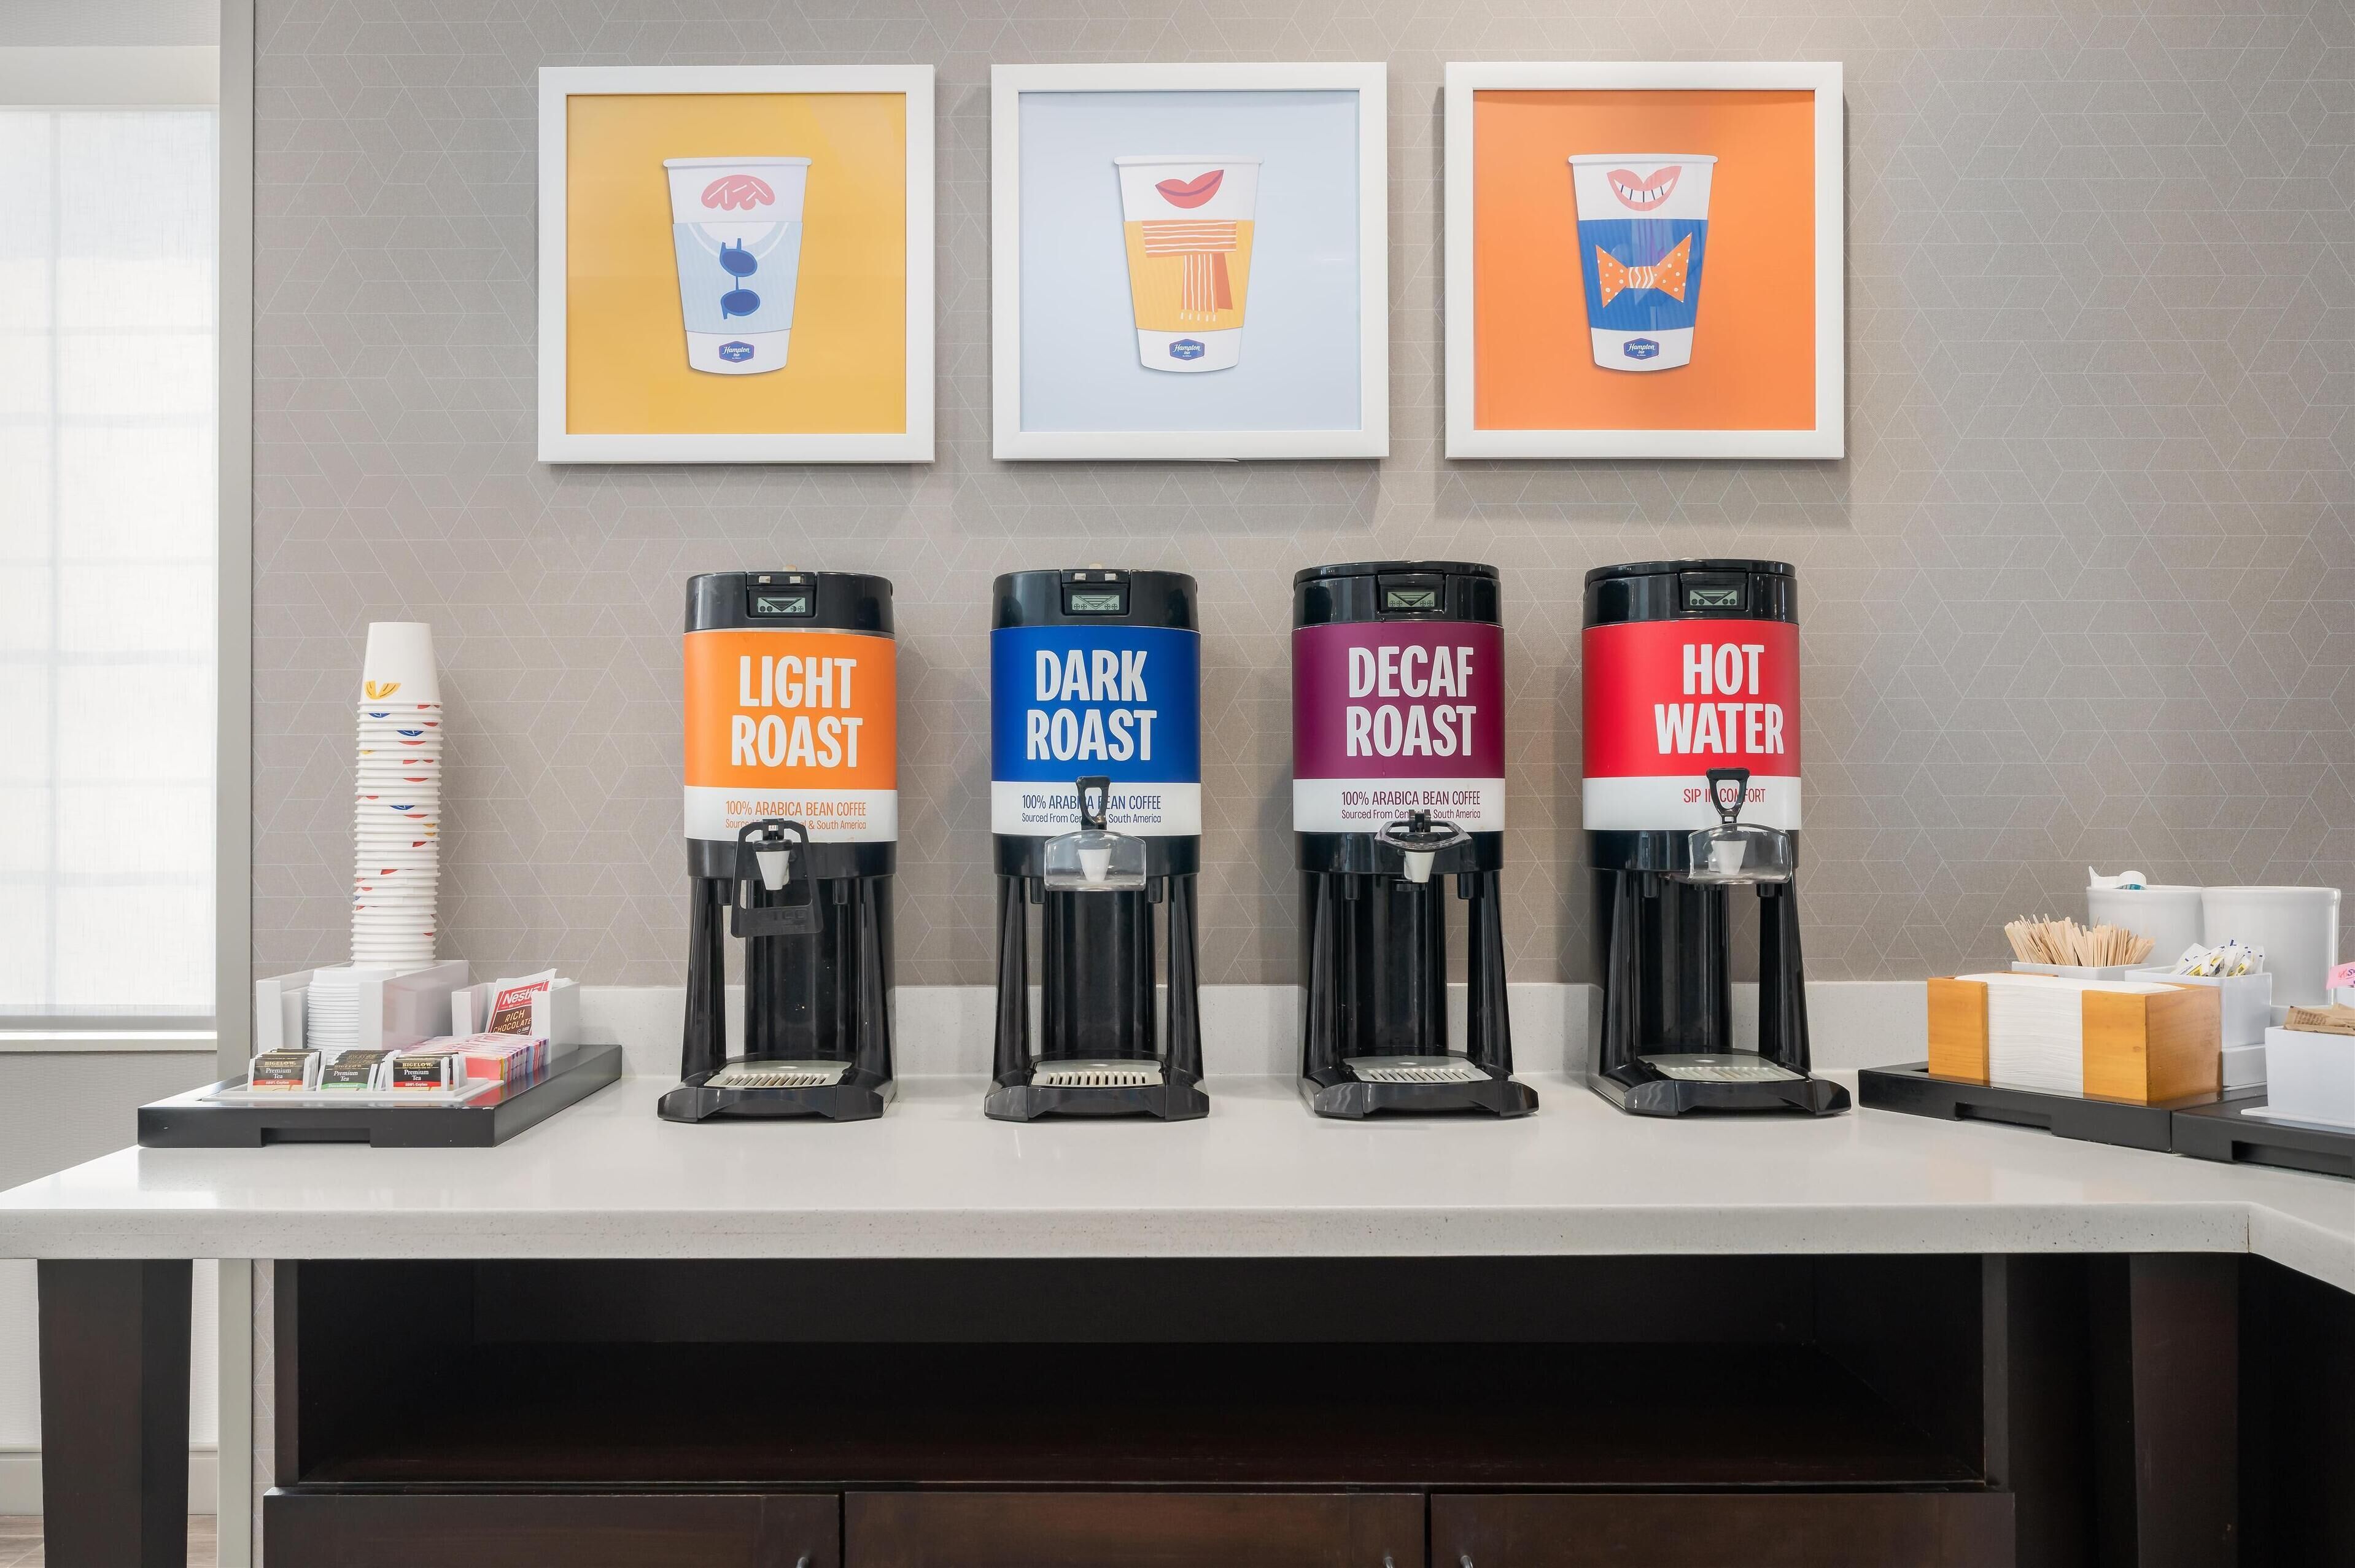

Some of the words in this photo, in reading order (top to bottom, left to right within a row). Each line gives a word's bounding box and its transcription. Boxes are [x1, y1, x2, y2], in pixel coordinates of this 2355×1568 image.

[722, 346, 750, 355] Hampton
[1173, 344, 1201, 352] Hampton
[1036, 650, 1147, 702] DARK
[1349, 645, 1474, 699] DECAF
[1683, 643, 1764, 695] HOT
[739, 655, 857, 708] LIGHT
[1026, 708, 1157, 761] ROAST
[1346, 705, 1476, 757] ROAST
[1654, 702, 1785, 755] WATER
[731, 715, 863, 768] ROAST
[1022, 794, 1046, 809] 100%
[1049, 795, 1094, 809] ARABIA
[1129, 795, 1162, 810] COFFEE
[1341, 791, 1369, 805] 100%
[1372, 791, 1419, 805] ARABICA
[1423, 791, 1449, 805] BEAN
[1452, 791, 1481, 805] COFFEE
[1683, 788, 1701, 803] SIP
[726, 801, 752, 815] 100%
[755, 801, 802, 816] ARABICA
[805, 802, 834, 816] BEAN
[837, 802, 866, 817] COFFEE
[1341, 809, 1371, 819] Sourced
[1373, 809, 1392, 819] From
[1433, 809, 1454, 819] South
[1456, 809, 1481, 819] America
[817, 820, 838, 829] South
[840, 820, 866, 829] America
[1022, 813, 1048, 823] Sourced
[1050, 813, 1068, 823] From
[1109, 813, 1131, 823] South
[1133, 813, 1162, 823] America
[505, 1009, 526, 1023] RICH
[493, 1017, 532, 1033] CHOCOLATE
